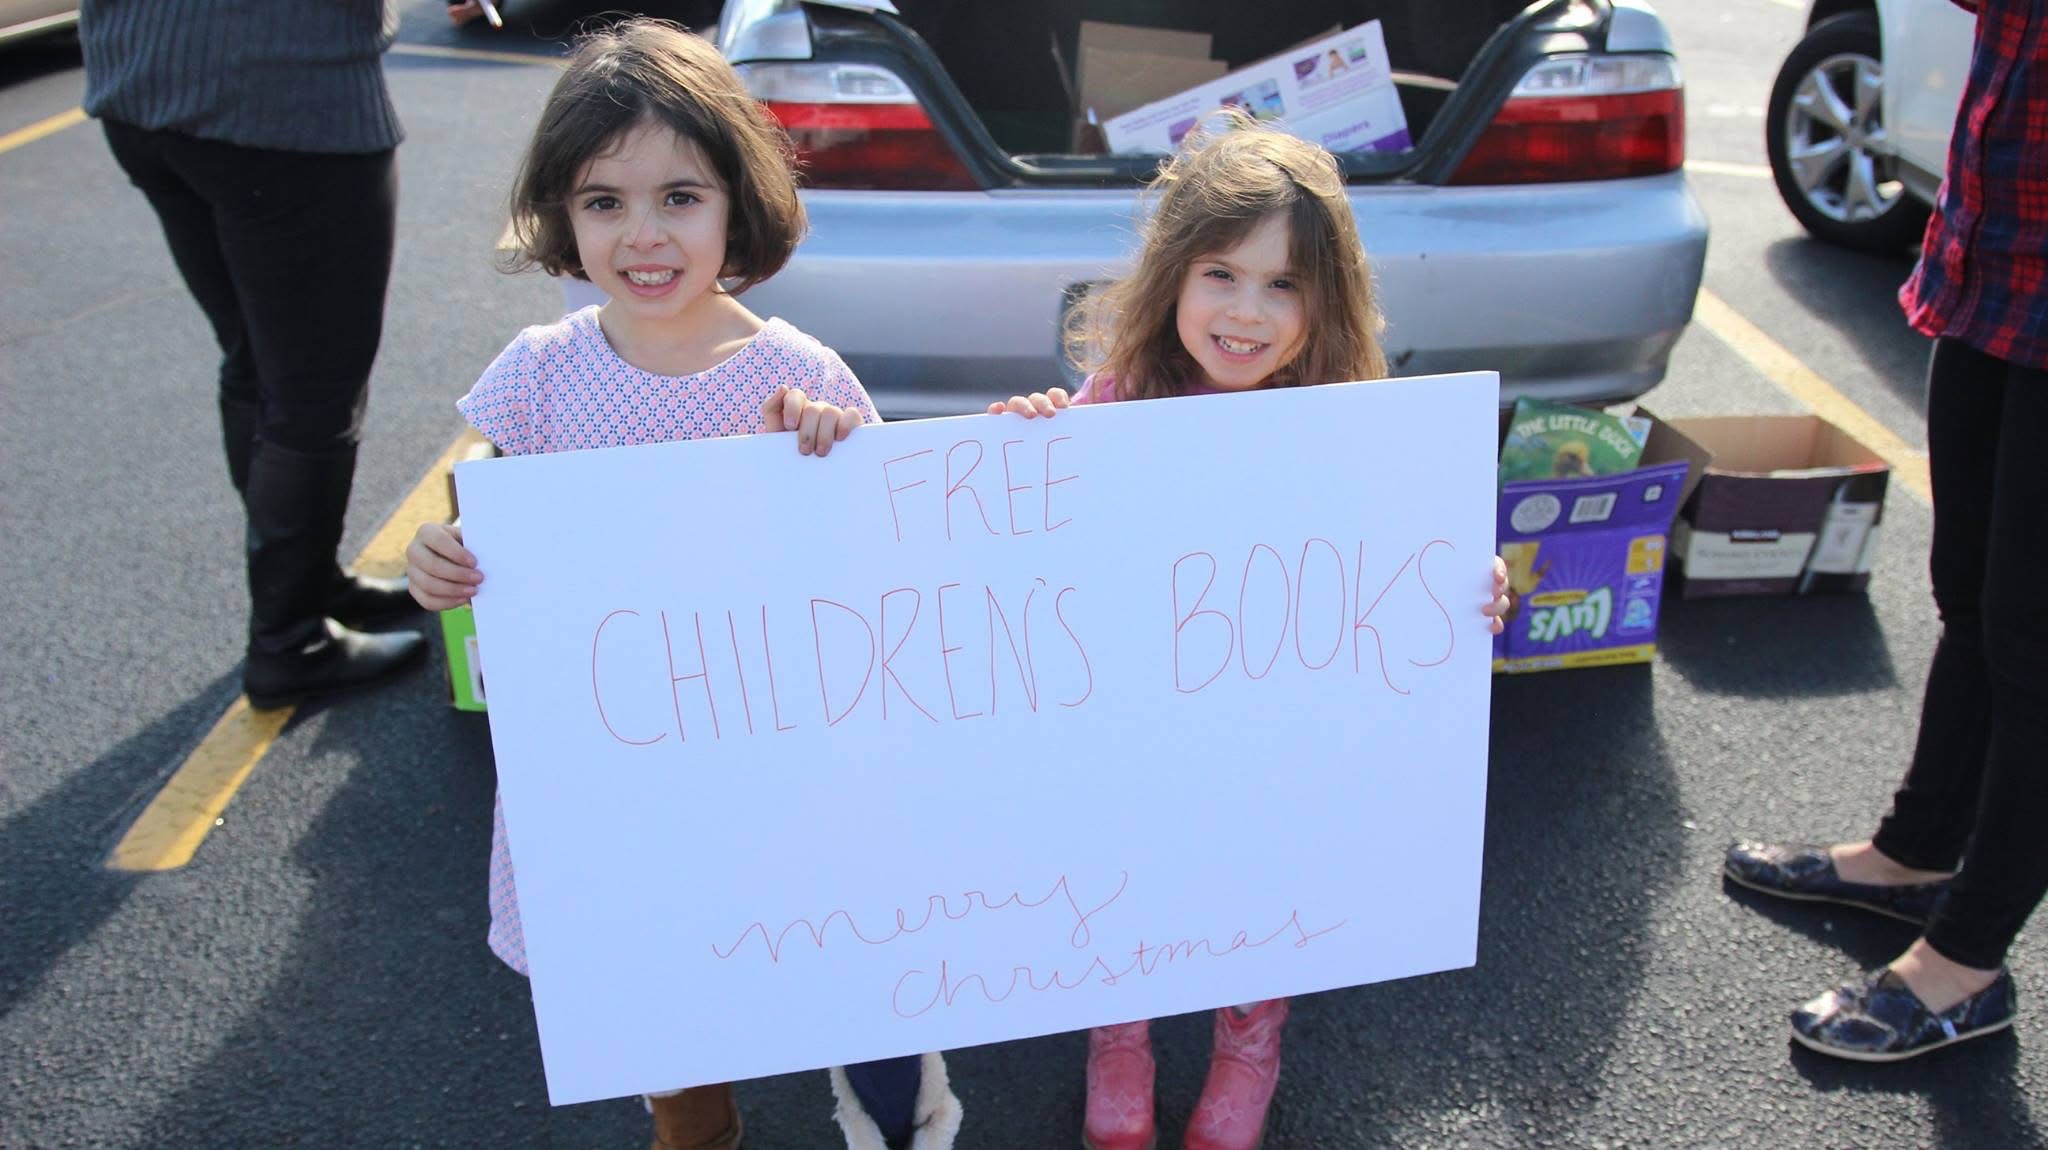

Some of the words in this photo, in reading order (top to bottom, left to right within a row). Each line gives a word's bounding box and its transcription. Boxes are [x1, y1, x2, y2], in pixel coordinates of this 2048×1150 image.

[1322, 119, 1371, 143] Diapers
[1516, 417, 1547, 438] THE
[1548, 414, 1600, 436] LITTLE
[1598, 425, 1636, 459] DUCK
[883, 437, 1079, 543] FREE
[592, 577, 1092, 745] CHILDREN'S
[1173, 538, 1456, 695] BOOKS
